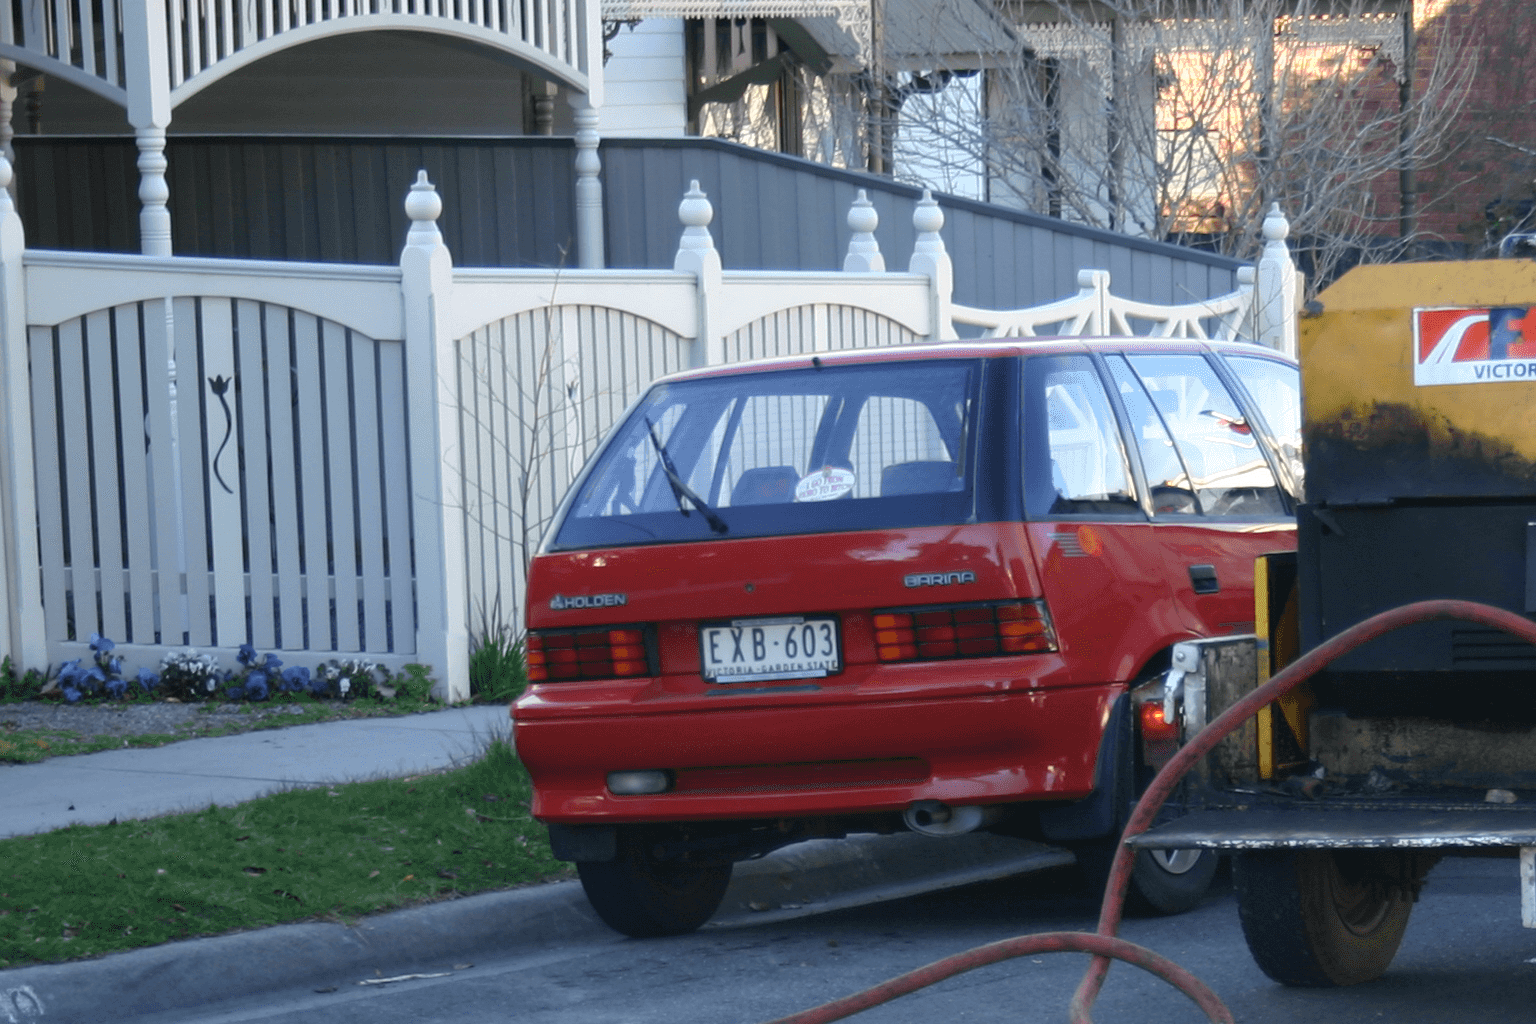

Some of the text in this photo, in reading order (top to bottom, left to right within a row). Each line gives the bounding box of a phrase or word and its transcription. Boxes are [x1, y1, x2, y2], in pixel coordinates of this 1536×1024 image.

[904, 571, 975, 588] BARINA
[564, 594, 626, 609] HOLDEN
[761, 662, 805, 673] GARDEN
[808, 660, 839, 671] STATE
